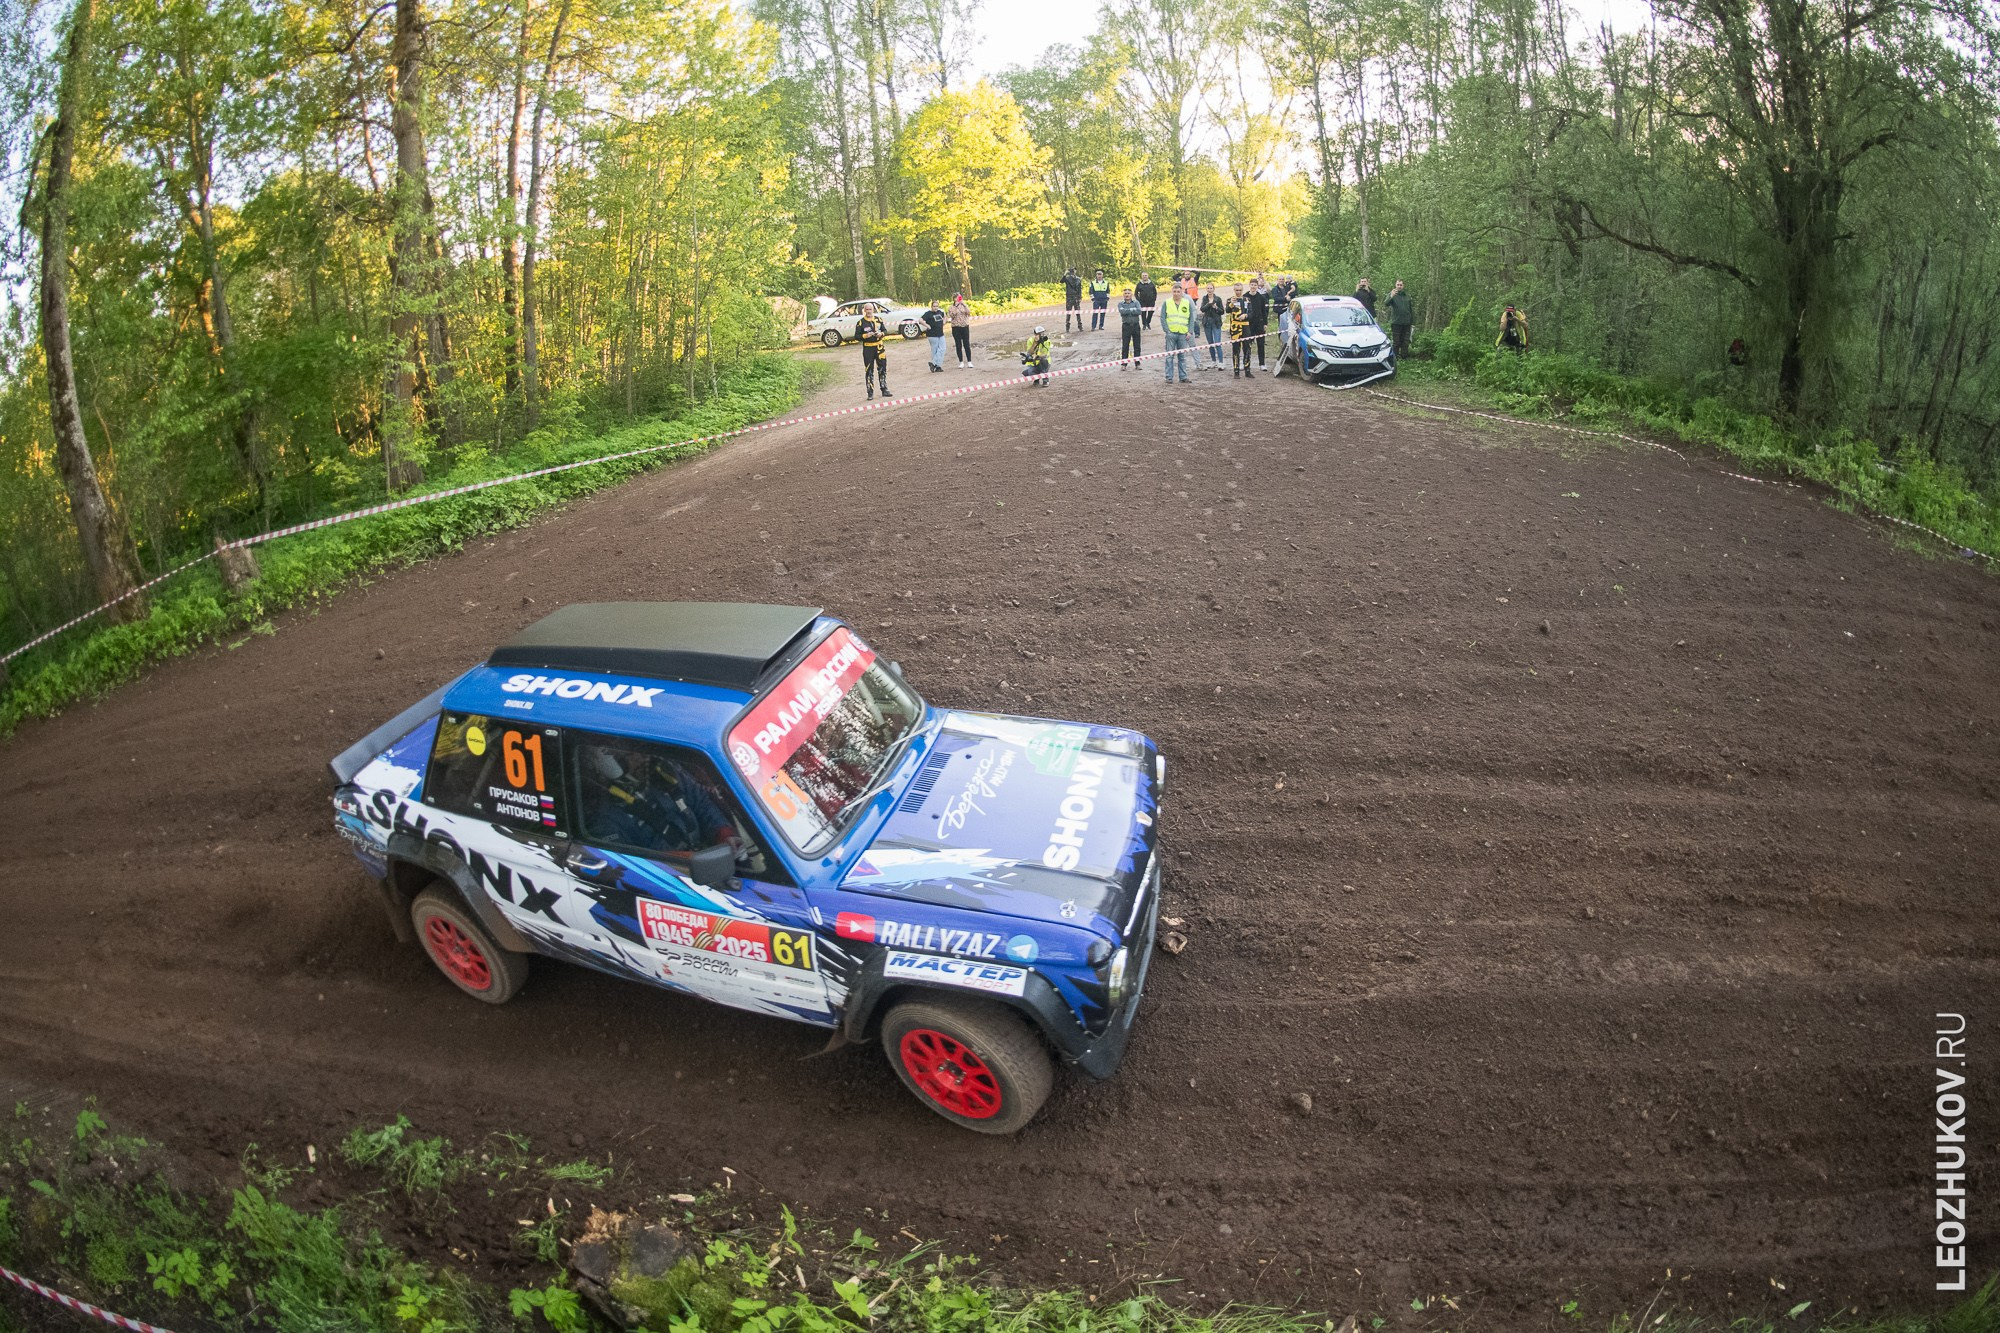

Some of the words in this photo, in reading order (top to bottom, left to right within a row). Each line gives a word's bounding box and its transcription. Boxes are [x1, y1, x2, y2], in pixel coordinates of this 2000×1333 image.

[501, 674, 665, 708] SHONX
[753, 689, 818, 755] РАЛЛИ
[810, 642, 860, 695] РОССИИ
[502, 730, 546, 792] 61
[489, 786, 539, 807] ПРУСАКОВ
[496, 802, 541, 822] АНТОНОВ
[761, 768, 810, 821] 61
[1042, 754, 1108, 871] SHONX
[645, 903, 662, 920] 80
[663, 908, 708, 929] ПОБЕДА!
[647, 920, 694, 947] 1945
[714, 934, 768, 962] 2025
[773, 931, 812, 969] 61
[880, 920, 1001, 959] RALLYZAZ
[682, 958, 738, 978] РОССИИ
[889, 953, 1023, 981] МАСТЕР
[962, 976, 1013, 992] СПОРТ
